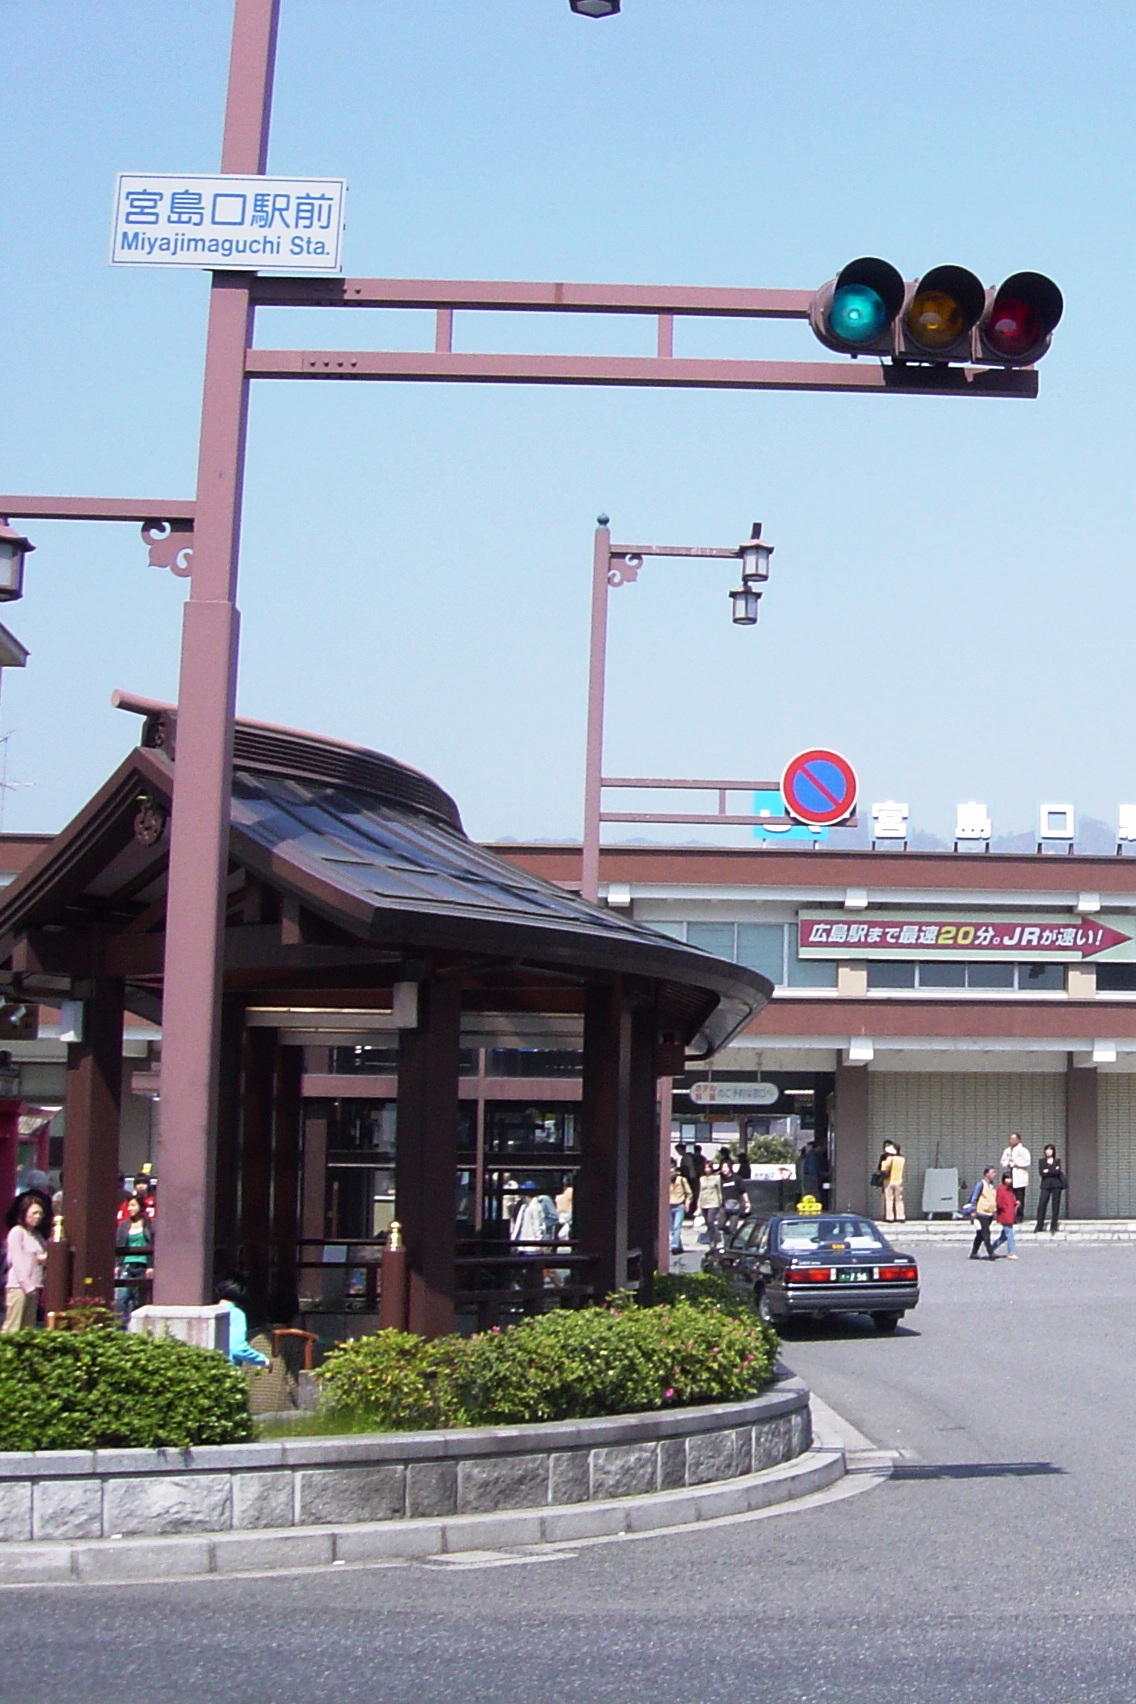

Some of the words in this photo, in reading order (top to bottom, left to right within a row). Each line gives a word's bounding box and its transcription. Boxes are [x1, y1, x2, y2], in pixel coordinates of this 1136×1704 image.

[124, 188, 335, 230] 宮島口駅前
[120, 231, 281, 258] Miyajimaguchi
[289, 235, 331, 256] Sta.
